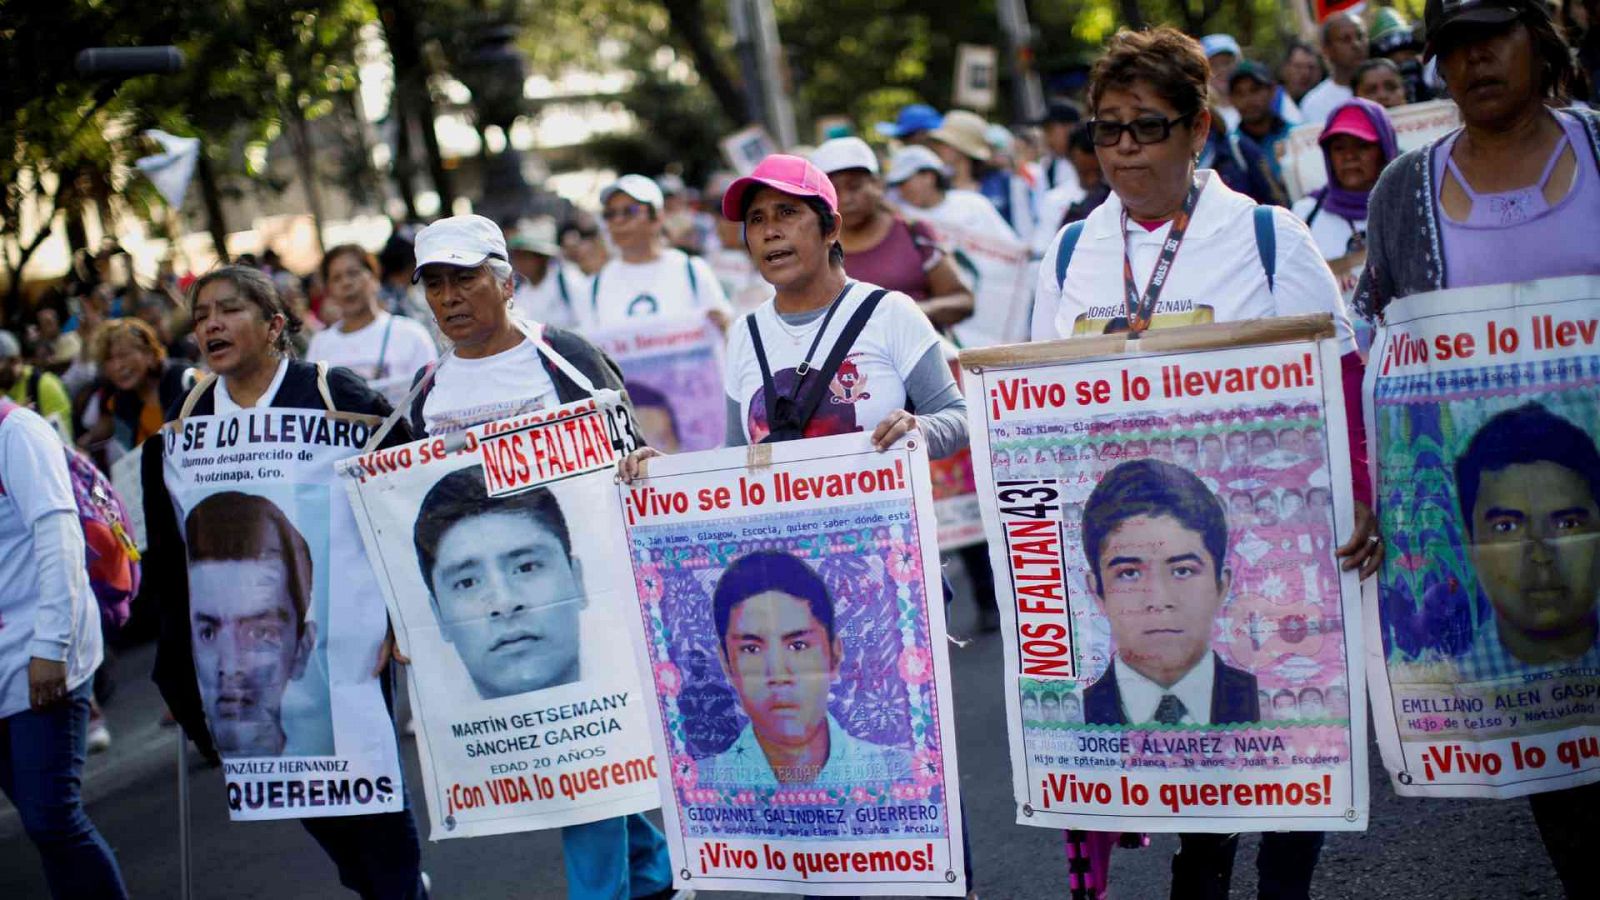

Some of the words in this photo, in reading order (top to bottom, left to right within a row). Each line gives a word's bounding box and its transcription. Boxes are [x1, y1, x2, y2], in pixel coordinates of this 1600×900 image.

[1088, 306, 1117, 318] JORGE
[1165, 299, 1193, 313] NAVA
[1383, 332, 1429, 375] ¡Vivo
[1435, 333, 1475, 360] se
[1487, 320, 1519, 355] lo
[990, 378, 1065, 420] ¡Vivo
[1075, 379, 1111, 406] se
[1121, 369, 1150, 402] lo
[1162, 352, 1314, 398] llevaron!
[182, 421, 207, 452] SE
[216, 416, 239, 449] LO
[249, 413, 371, 450] LLEVARO
[995, 428, 1010, 437] Yo,
[217, 449, 293, 467] desaparecido
[298, 450, 313, 462] de
[419, 438, 447, 465] se
[481, 434, 531, 492] NOS
[529, 413, 615, 480] FALTAN
[194, 468, 254, 485] Ayotzinapa,
[258, 467, 285, 479] Gro.
[625, 486, 689, 525] ¡Vivo
[698, 486, 731, 511] se
[739, 476, 765, 506] lo
[773, 459, 906, 503] llevaron!
[996, 478, 1059, 519] 43!
[697, 530, 737, 542] Glasgow,
[742, 525, 781, 537] Escocia,
[786, 521, 819, 533] quiero
[823, 518, 851, 529] saber
[855, 513, 884, 525] dónde
[888, 510, 911, 521] está
[1007, 520, 1065, 614] FALTAN
[1020, 622, 1070, 677] NOS
[452, 715, 508, 738] MARTÍN
[511, 692, 629, 729] GETSEMANY
[1402, 698, 1484, 713] EMILIANO
[1494, 690, 1541, 710] ALEN
[1552, 683, 1600, 701] GASP
[1408, 719, 1437, 731] Hijo
[1444, 718, 1458, 729] de
[1464, 718, 1502, 730] Celso
[1509, 716, 1517, 727] y
[1525, 702, 1595, 721] Natividad
[466, 735, 541, 758] SÁNCHEZ
[544, 716, 622, 746] GARCÍA
[1078, 736, 1130, 753] JORGE
[1142, 734, 1223, 754] ÁLVAREZ
[1234, 735, 1286, 753] NAVA
[225, 760, 275, 775] ONZÁLEZ
[490, 761, 528, 775] EDAD
[533, 757, 551, 770] 20
[557, 746, 607, 765] AÑOS
[1034, 754, 1054, 765] Hijo
[1058, 755, 1069, 764] de
[1120, 758, 1126, 768] y
[1183, 758, 1195, 767] 19
[1273, 756, 1284, 766] R.
[1291, 755, 1340, 765] Escudero
[1421, 744, 1502, 781] ¡Vivo
[1511, 741, 1546, 770] lo
[227, 775, 394, 812] QUEREMOS
[446, 783, 485, 816] ¡Con
[485, 776, 534, 806] VIDA
[533, 773, 555, 800] lo
[1041, 772, 1112, 809] ¡Vivo
[1120, 775, 1149, 806] lo
[1159, 774, 1332, 814] queremos!
[688, 807, 756, 822] GIOVANNI
[763, 808, 847, 824] GALINDREZ
[855, 805, 938, 822] GUERRERO
[904, 823, 940, 833] Arcelia
[699, 842, 758, 874] ¡Vivo
[763, 843, 787, 871] lo
[792, 843, 935, 880] queremos!
